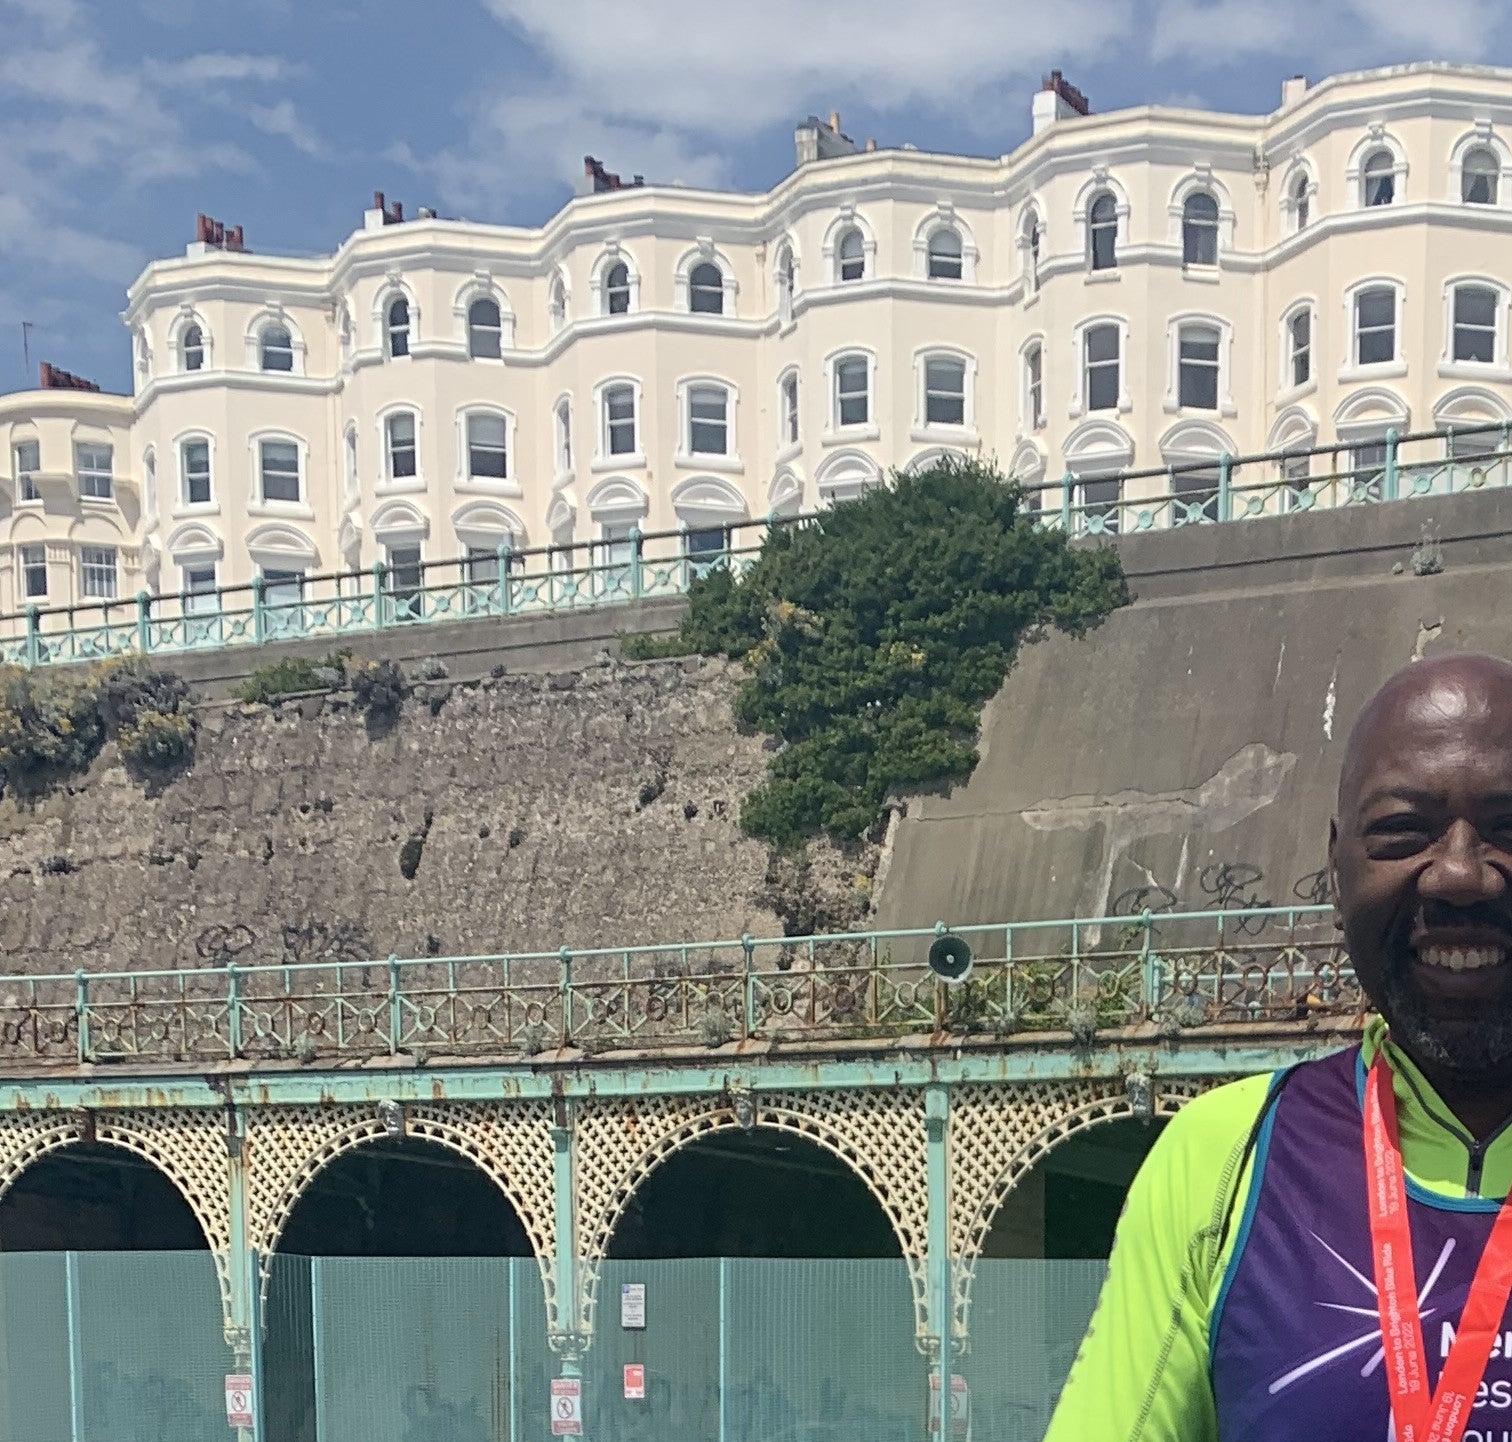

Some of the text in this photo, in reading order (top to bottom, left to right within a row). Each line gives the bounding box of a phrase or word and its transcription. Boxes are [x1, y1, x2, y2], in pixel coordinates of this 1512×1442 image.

[1382, 1242, 1408, 1395] London to Brighton Bike Ride
[1402, 1321, 1415, 1350] 2022
[1409, 1350, 1419, 1379] June
[1441, 1390, 1455, 1404] 19
[1432, 1403, 1449, 1431] June
[1443, 1394, 1467, 1436] London
